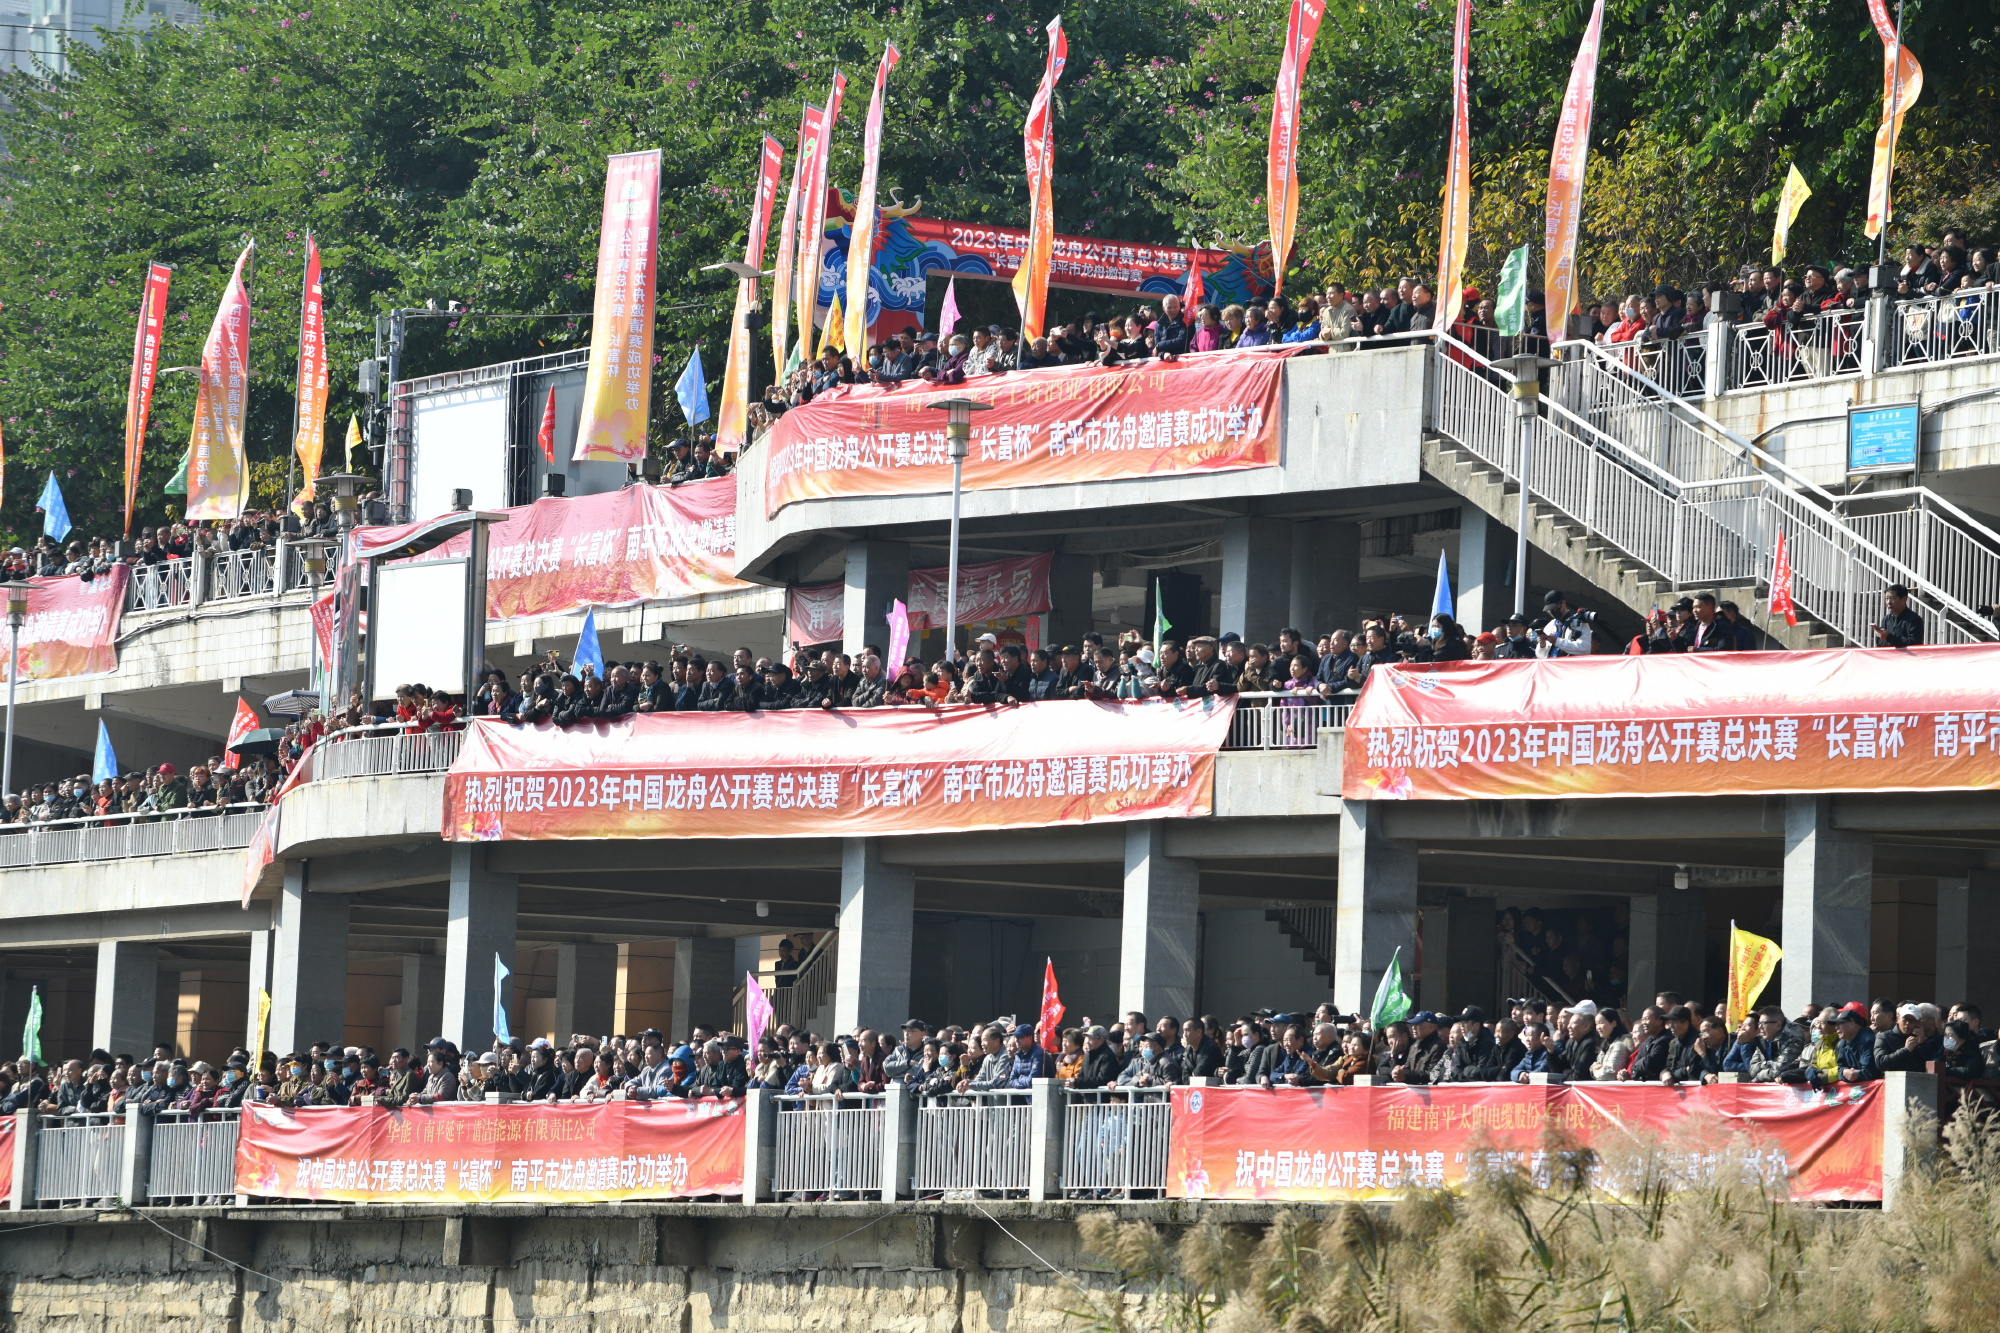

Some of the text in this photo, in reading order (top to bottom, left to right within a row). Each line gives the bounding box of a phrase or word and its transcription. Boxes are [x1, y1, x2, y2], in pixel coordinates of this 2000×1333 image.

[951, 227, 1188, 272] 2023年中龙舟公开赛总决赛
[989, 251, 1142, 282] “长富南平市龙舟邀请赛
